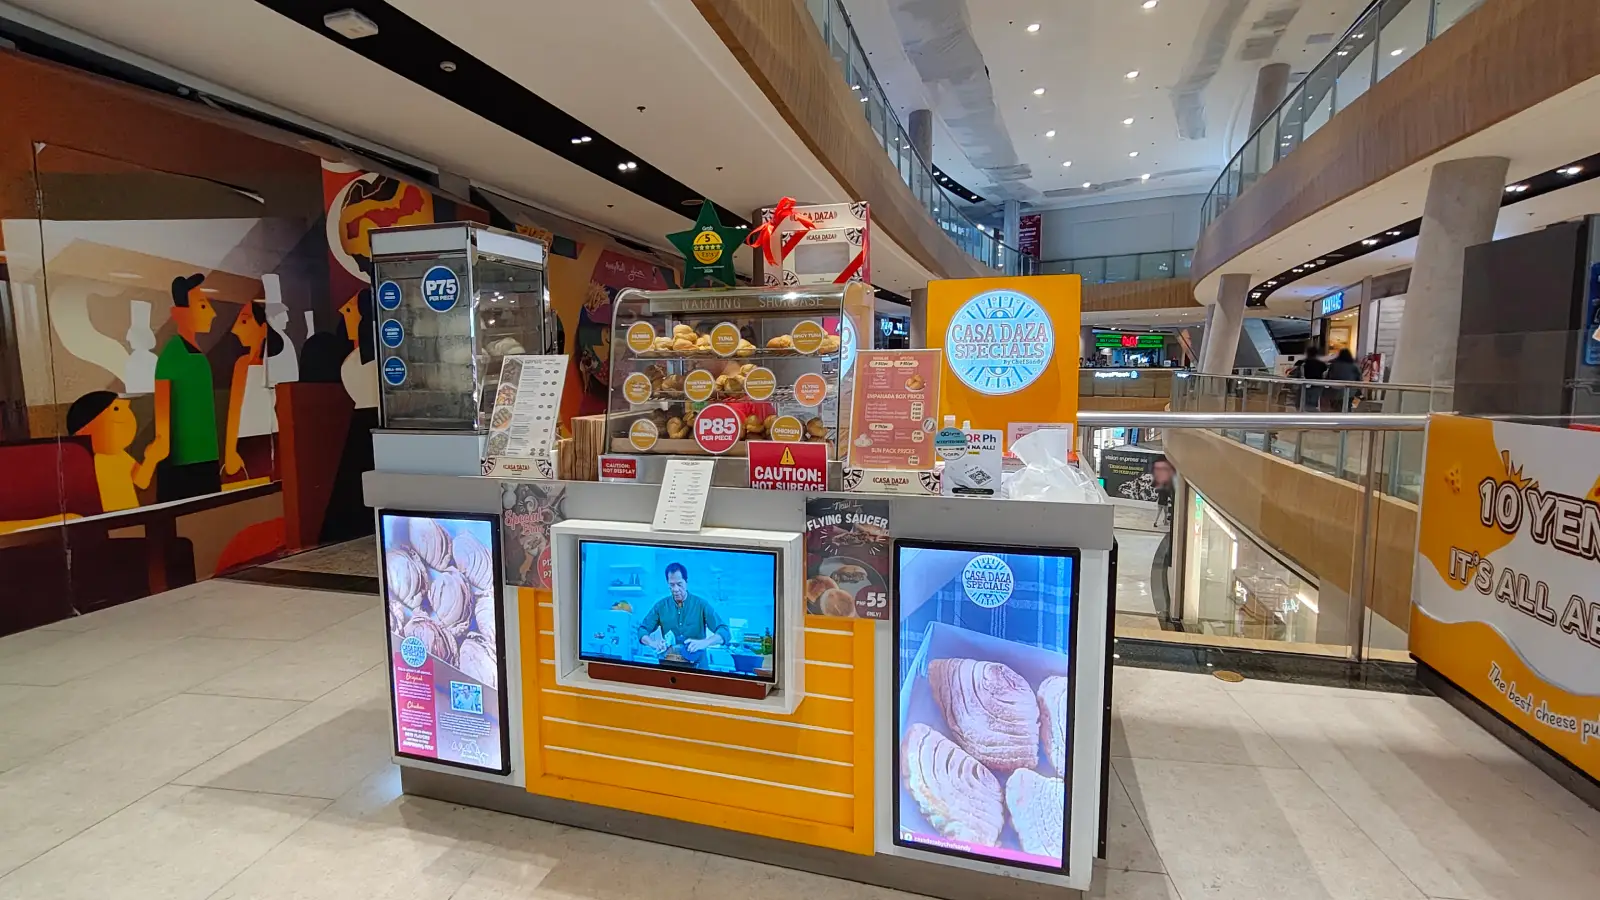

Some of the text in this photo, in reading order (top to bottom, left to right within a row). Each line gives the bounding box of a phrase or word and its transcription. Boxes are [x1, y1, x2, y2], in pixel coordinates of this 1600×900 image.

[814, 211, 834, 220] DAZA
[705, 234, 711, 242] 5
[425, 278, 457, 296] P75
[682, 297, 824, 309] WARMING SHOWCASE
[951, 322, 1048, 343] CASA DAZA
[954, 343, 1045, 360] SPECIALS
[700, 418, 736, 435] P85
[966, 434, 997, 443] QR Ph
[754, 466, 822, 482] CAUTION:
[752, 481, 825, 492] HOT SURFACE
[806, 513, 889, 531] FLYING SAUCER
[1478, 477, 1600, 563] 10 YEN
[965, 569, 1011, 583] CASA DAZA
[966, 580, 1010, 591] SPECIALS
[1449, 546, 1495, 595] IT'S
[1495, 567, 1557, 627] ALL
[867, 592, 887, 608] 55
[1487, 661, 1506, 692] The
[1508, 682, 1533, 714] best
[1535, 701, 1578, 734] cheese
